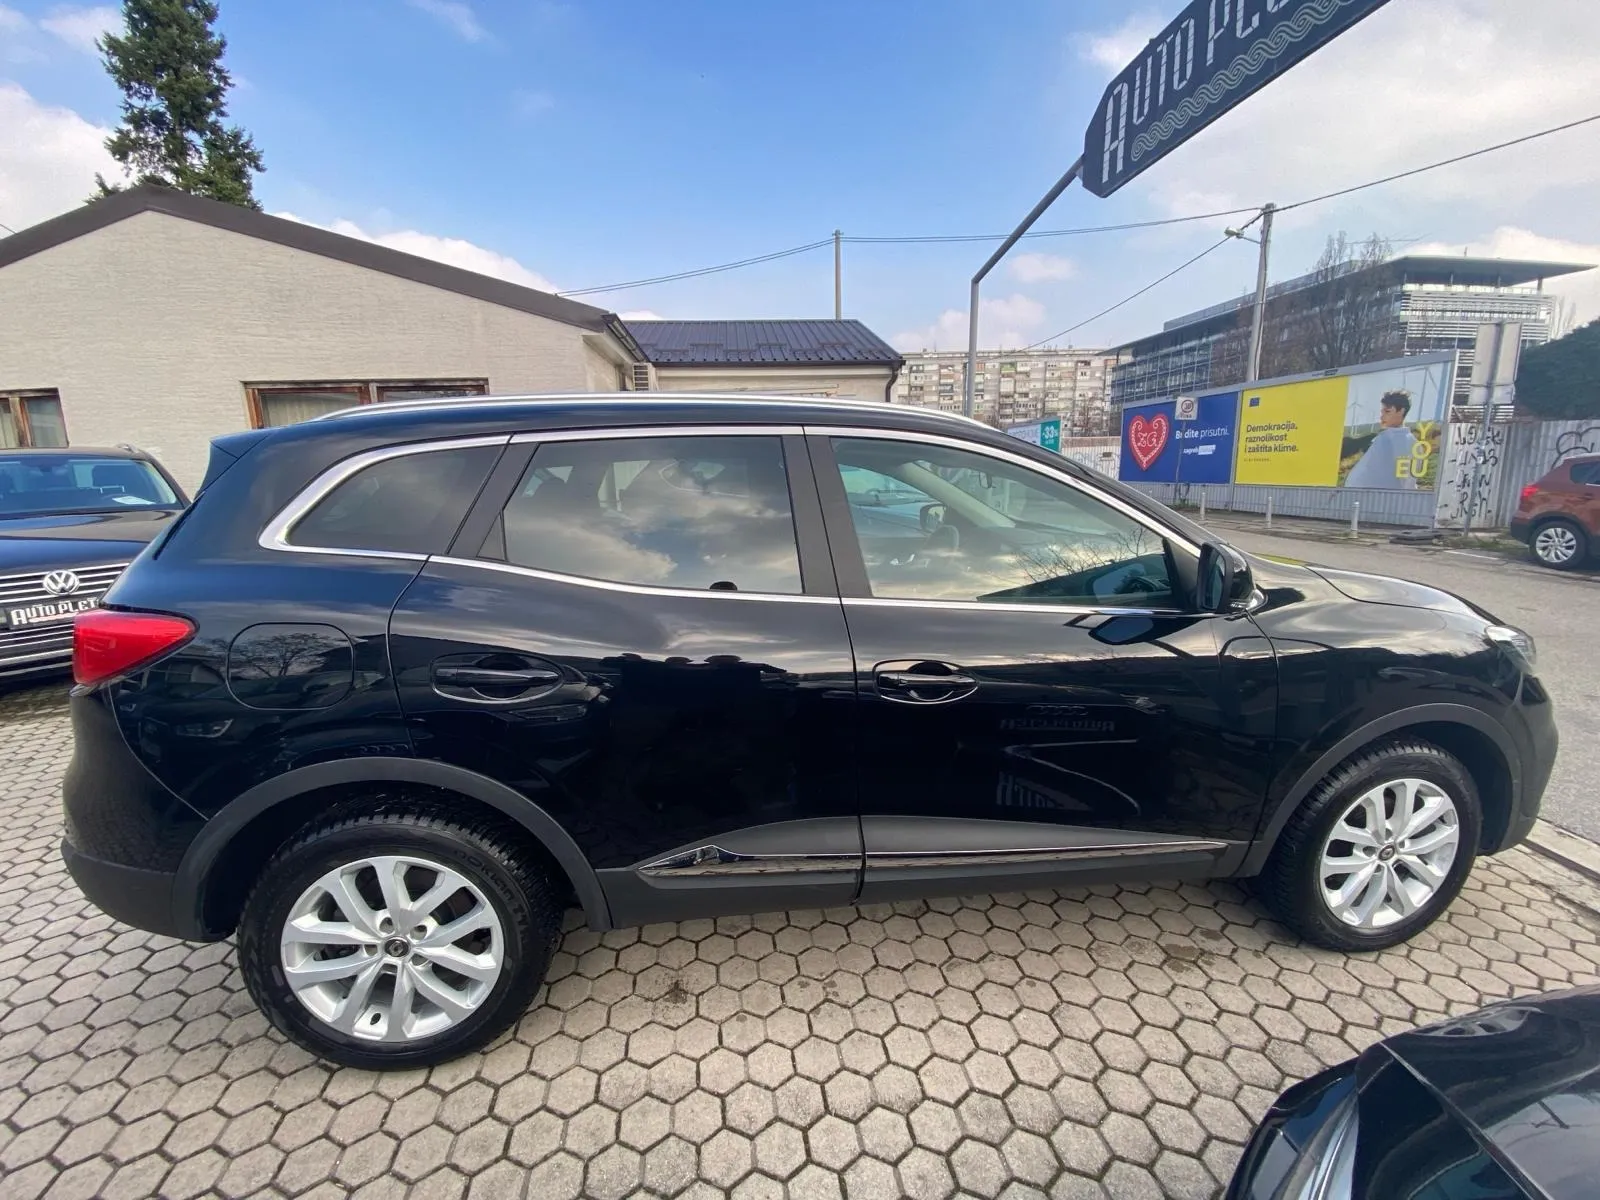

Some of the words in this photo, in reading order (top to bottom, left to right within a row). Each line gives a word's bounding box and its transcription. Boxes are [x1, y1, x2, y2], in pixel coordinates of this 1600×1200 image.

[1102, 17, 1195, 184] AUTO
[1206, 0, 1290, 66] PL
[1245, 433, 1287, 443] raznolikost
[1247, 444, 1273, 453] zaštita
[10, 603, 56, 626] AUTO
[58, 597, 99, 613] PLET
